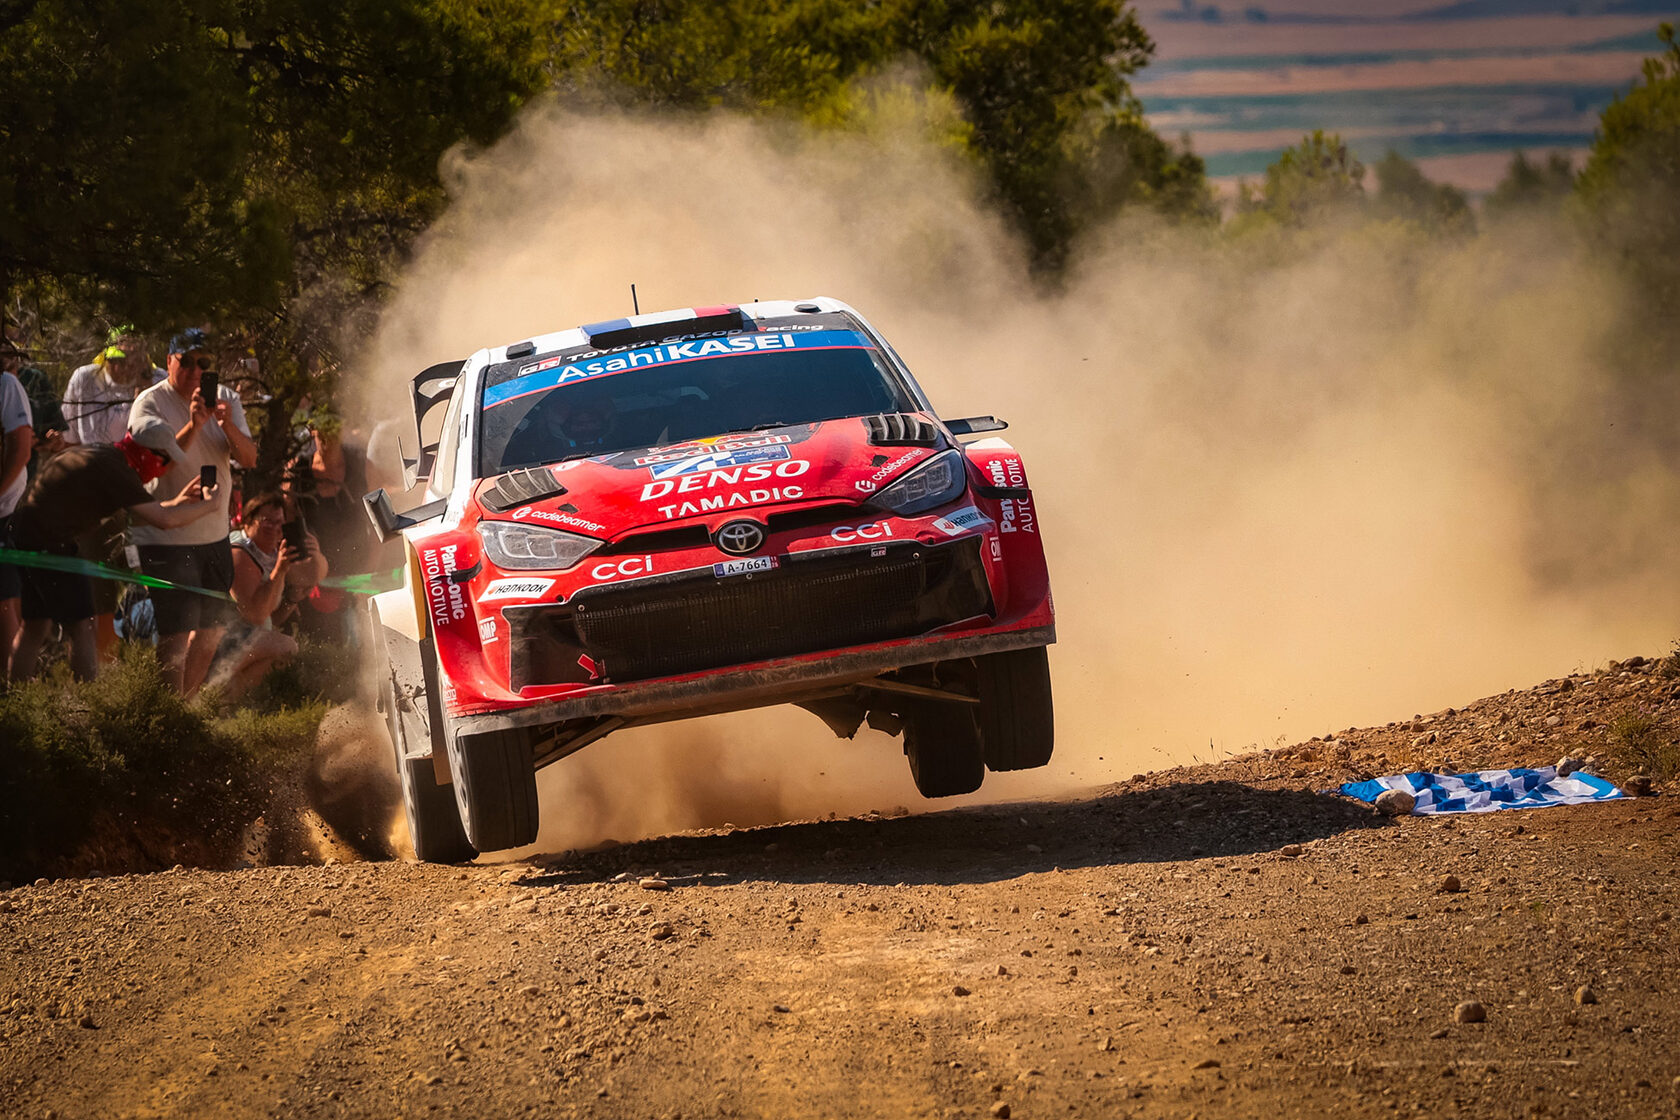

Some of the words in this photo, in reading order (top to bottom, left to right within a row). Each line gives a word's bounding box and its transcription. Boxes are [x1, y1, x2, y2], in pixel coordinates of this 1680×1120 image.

[640, 460, 810, 502] DENSO
[872, 448, 922, 481] codebeamer
[658, 486, 804, 519] TAMADIC
[531, 510, 604, 532] codebeamer
[440, 544, 468, 620] Pansonic
[728, 559, 767, 573] A-7664
[480, 621, 497, 641] OMP
